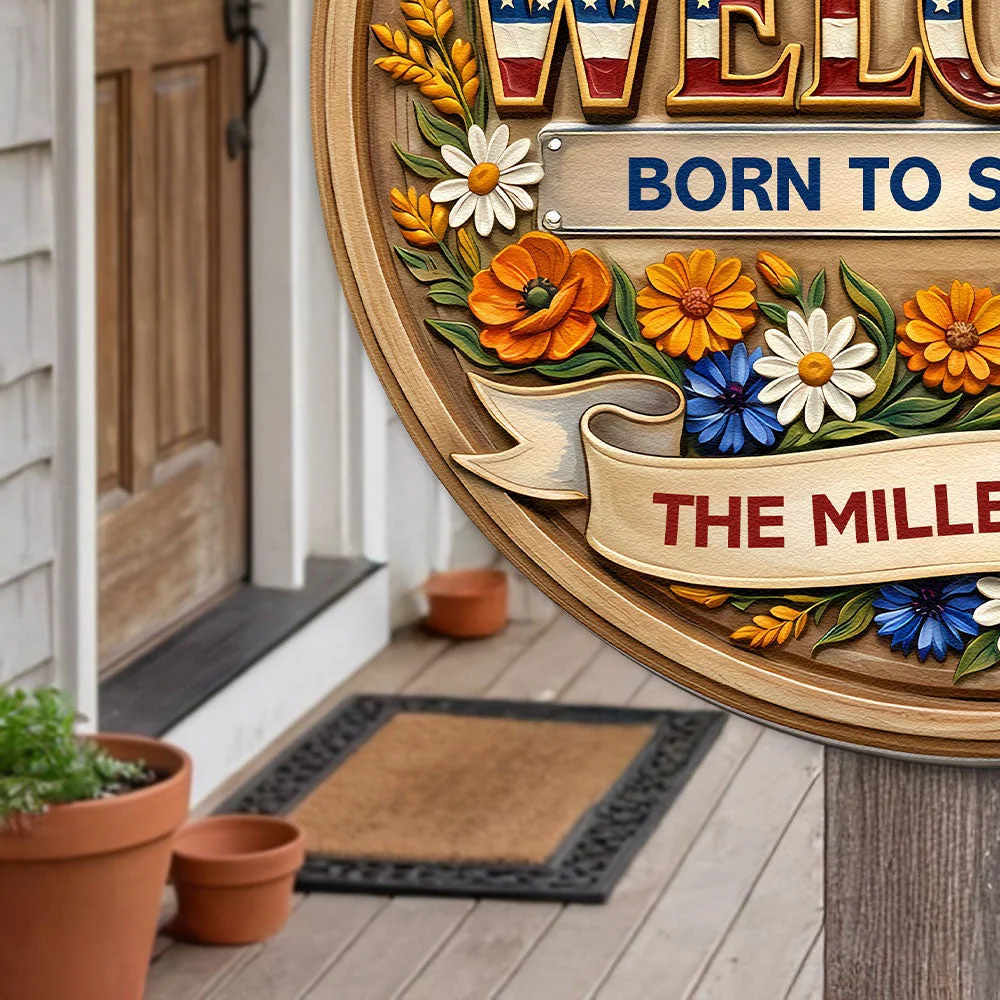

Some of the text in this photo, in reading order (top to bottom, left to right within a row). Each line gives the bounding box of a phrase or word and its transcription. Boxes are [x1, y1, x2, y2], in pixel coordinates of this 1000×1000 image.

[628, 156, 821, 211] BORN
[848, 156, 942, 211] TO
[652, 492, 785, 549] THE
